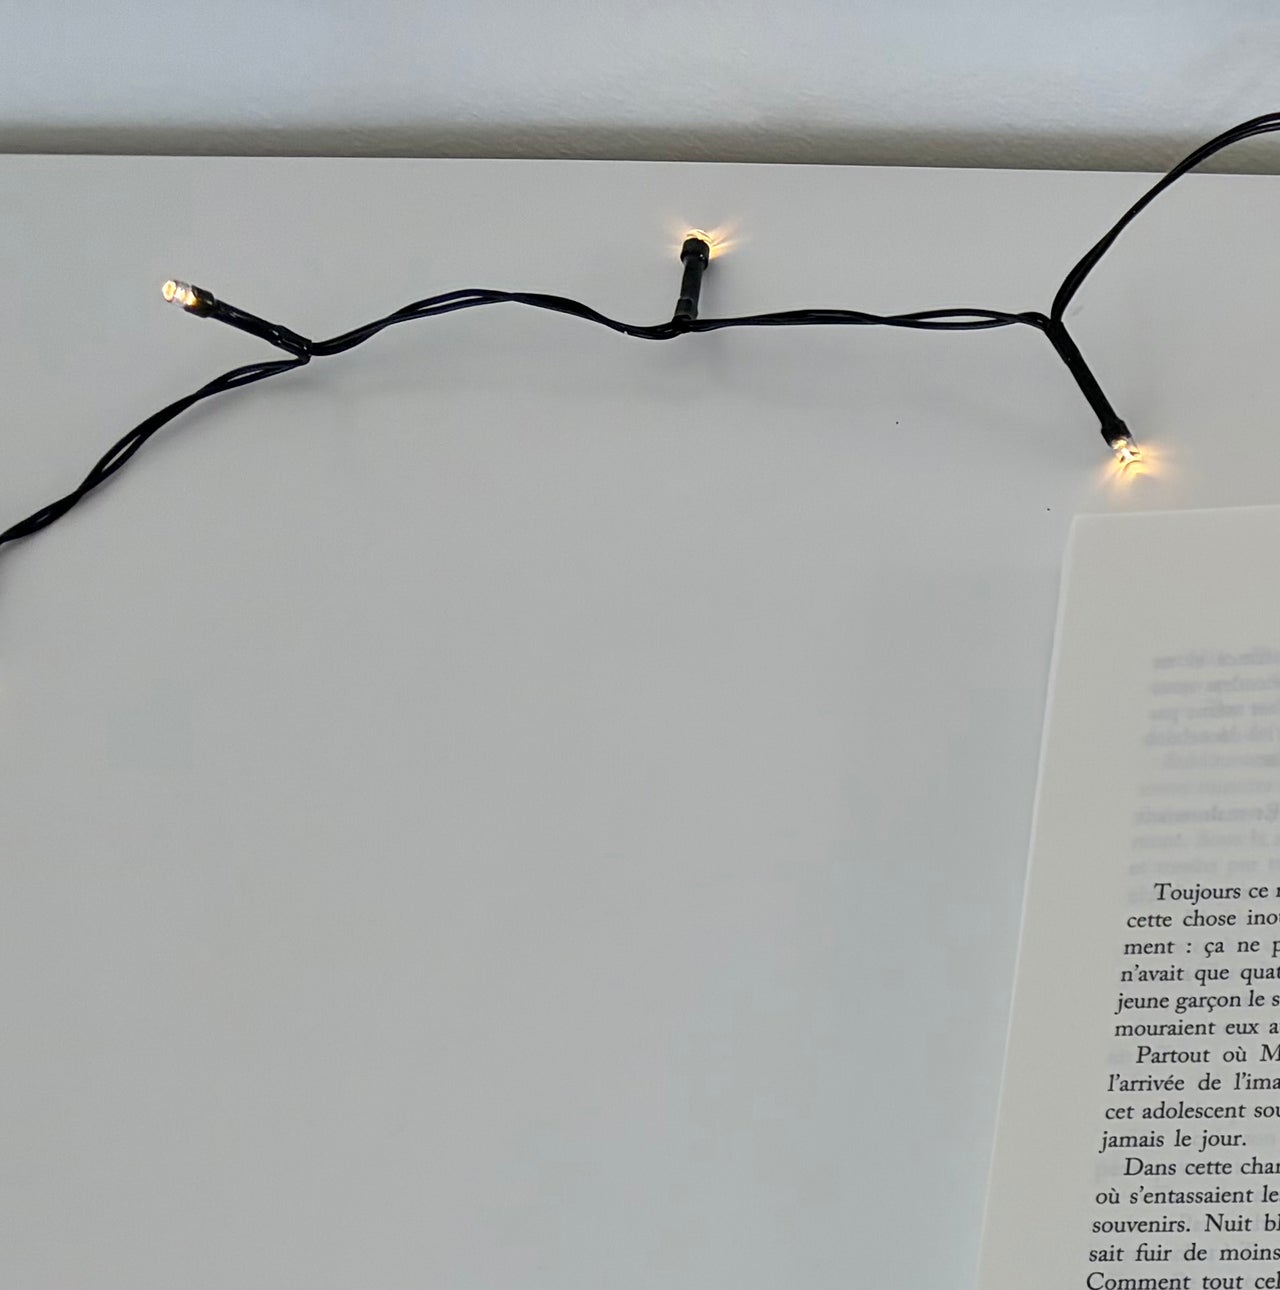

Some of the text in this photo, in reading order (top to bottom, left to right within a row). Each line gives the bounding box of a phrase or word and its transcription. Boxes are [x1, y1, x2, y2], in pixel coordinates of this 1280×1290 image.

[1153, 882, 1242, 906] Toujours
[1247, 886, 1269, 899] ce
[1126, 914, 1173, 929] cette
[1182, 908, 1237, 927] chose
[1113, 992, 1170, 1016] jeune
[1174, 995, 1242, 1015] garçon
[1247, 989, 1266, 1008] le
[1135, 1045, 1211, 1064] Partout
[1222, 1045, 1248, 1063] où
[1088, 1244, 1125, 1263] sait
[1134, 1242, 1173, 1262] fuir
[1183, 1242, 1208, 1262] de
